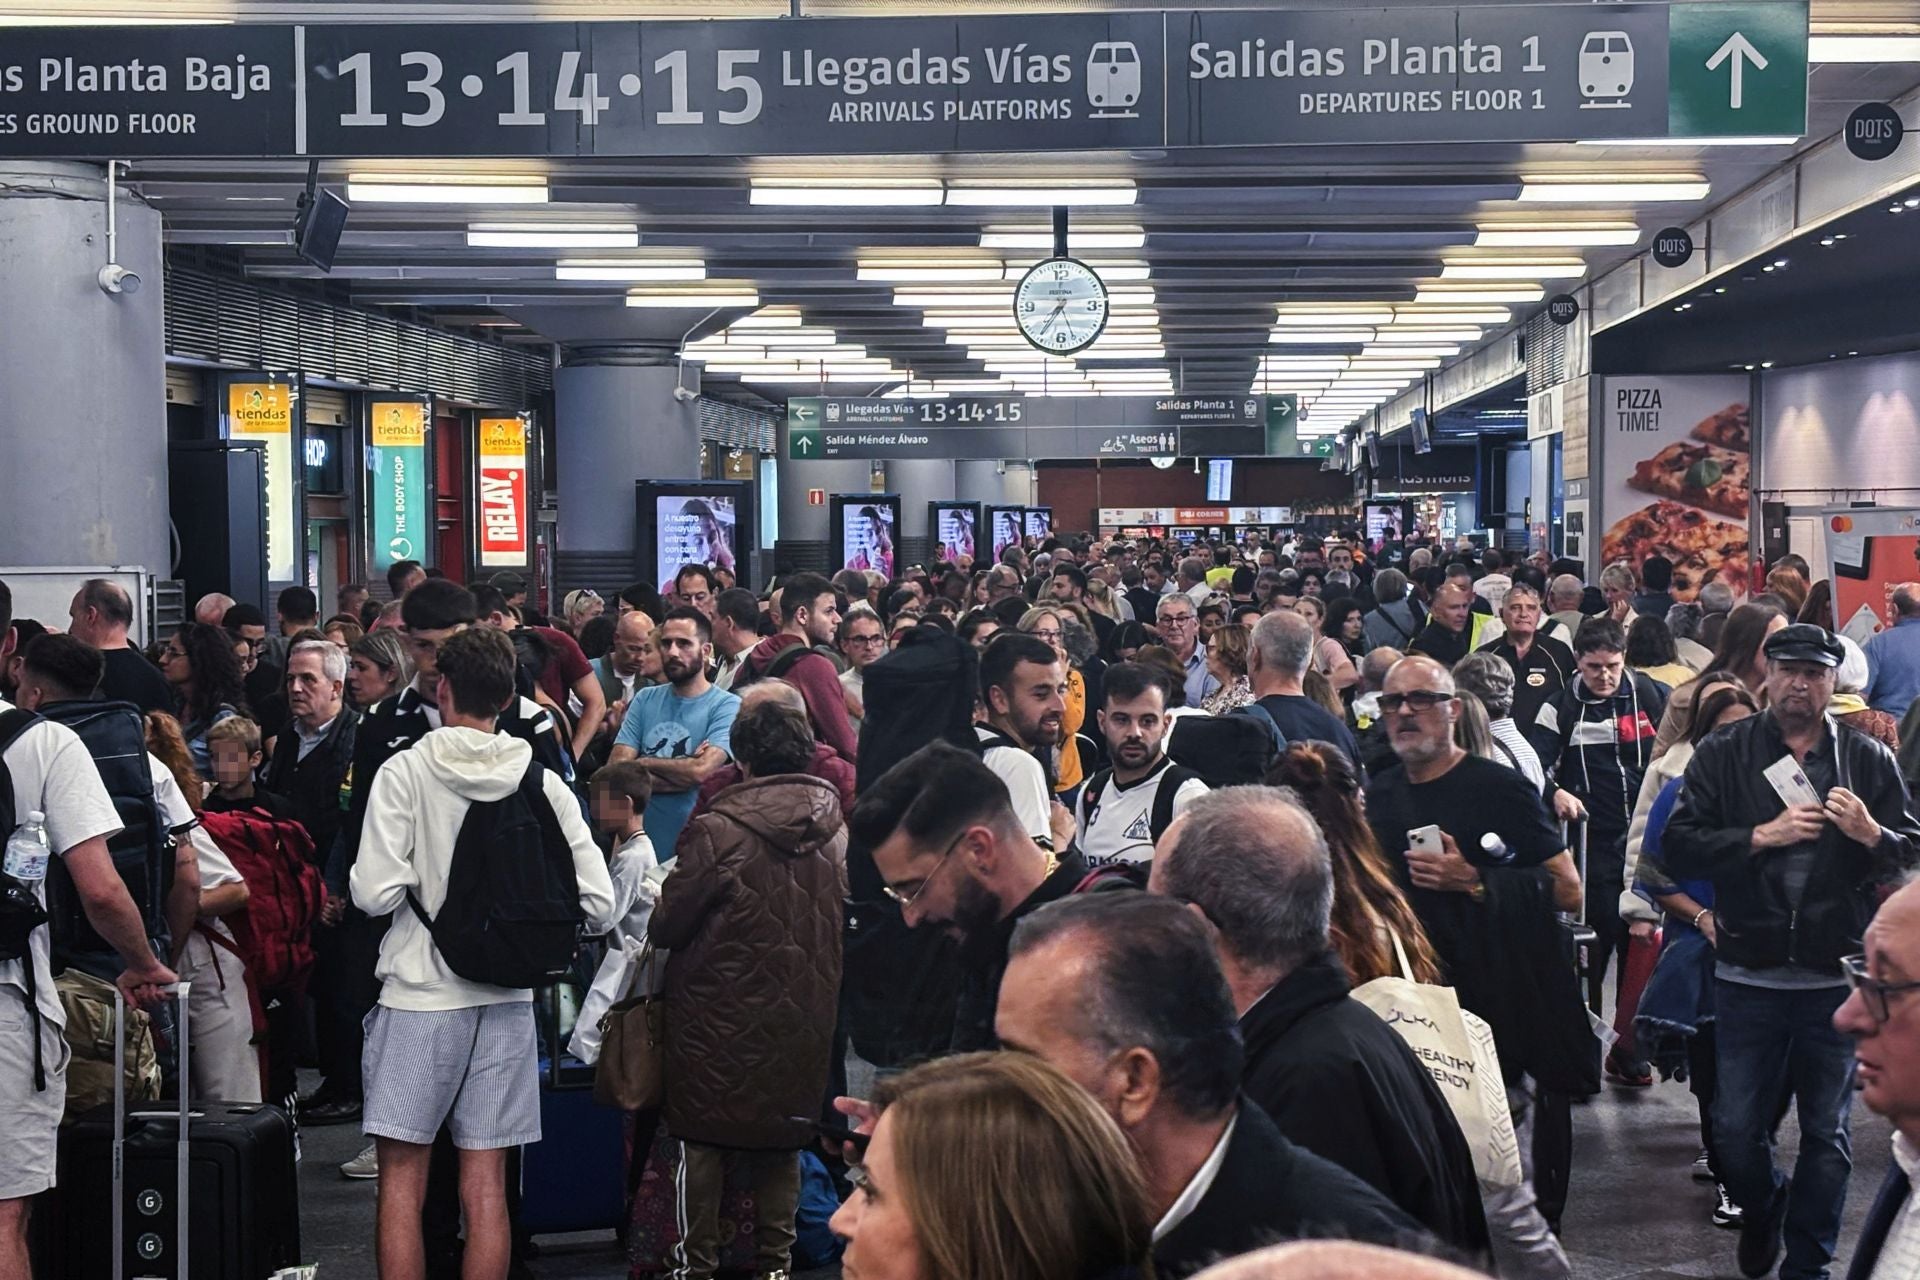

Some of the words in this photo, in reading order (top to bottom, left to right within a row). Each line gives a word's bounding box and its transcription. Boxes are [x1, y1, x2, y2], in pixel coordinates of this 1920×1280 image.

[1189, 38, 1345, 80] Salidas
[1363, 36, 1504, 77] Planta
[1522, 35, 1546, 73] 1
[782, 47, 971, 95] Llegadas
[985, 43, 1072, 84] Vías
[40, 57, 167, 92] Planta
[185, 54, 271, 100] Baja
[1299, 91, 1443, 115] DEPARTURES
[1450, 90, 1524, 112] FLOOR
[1531, 89, 1545, 110] 1
[828, 101, 935, 123] ARRIVALS
[943, 99, 1072, 121] PLATFORMS
[26, 114, 119, 134] GROUND
[129, 113, 196, 134] FLOOR
[1855, 119, 1893, 138] DOTS
[1659, 239, 1686, 253] DOTS
[1052, 270, 1069, 281] 12
[1024, 301, 1035, 312] 9
[1087, 300, 1097, 311] 3
[1055, 332, 1066, 343] 6
[1156, 400, 1191, 410] Salidas
[1194, 399, 1225, 409] Planta
[1229, 400, 1235, 409] 1
[1617, 388, 1662, 409] PIZZA
[236, 408, 286, 419] tiendas
[846, 403, 890, 415] Llegadas
[893, 403, 914, 414] Vías
[1617, 411, 1659, 432] TIME!
[378, 424, 420, 435] tiendas
[484, 438, 521, 446] tiendas
[826, 435, 856, 445] Salida
[858, 434, 896, 444] Méndez
[897, 433, 929, 444] Álvaro
[1129, 434, 1158, 444] Aseos
[306, 439, 326, 466] HOP
[394, 456, 405, 483] SHOP
[395, 484, 405, 511] BODY
[395, 514, 405, 533] THE
[145, 1196, 155, 1208] G
[145, 1240, 155, 1252] G
